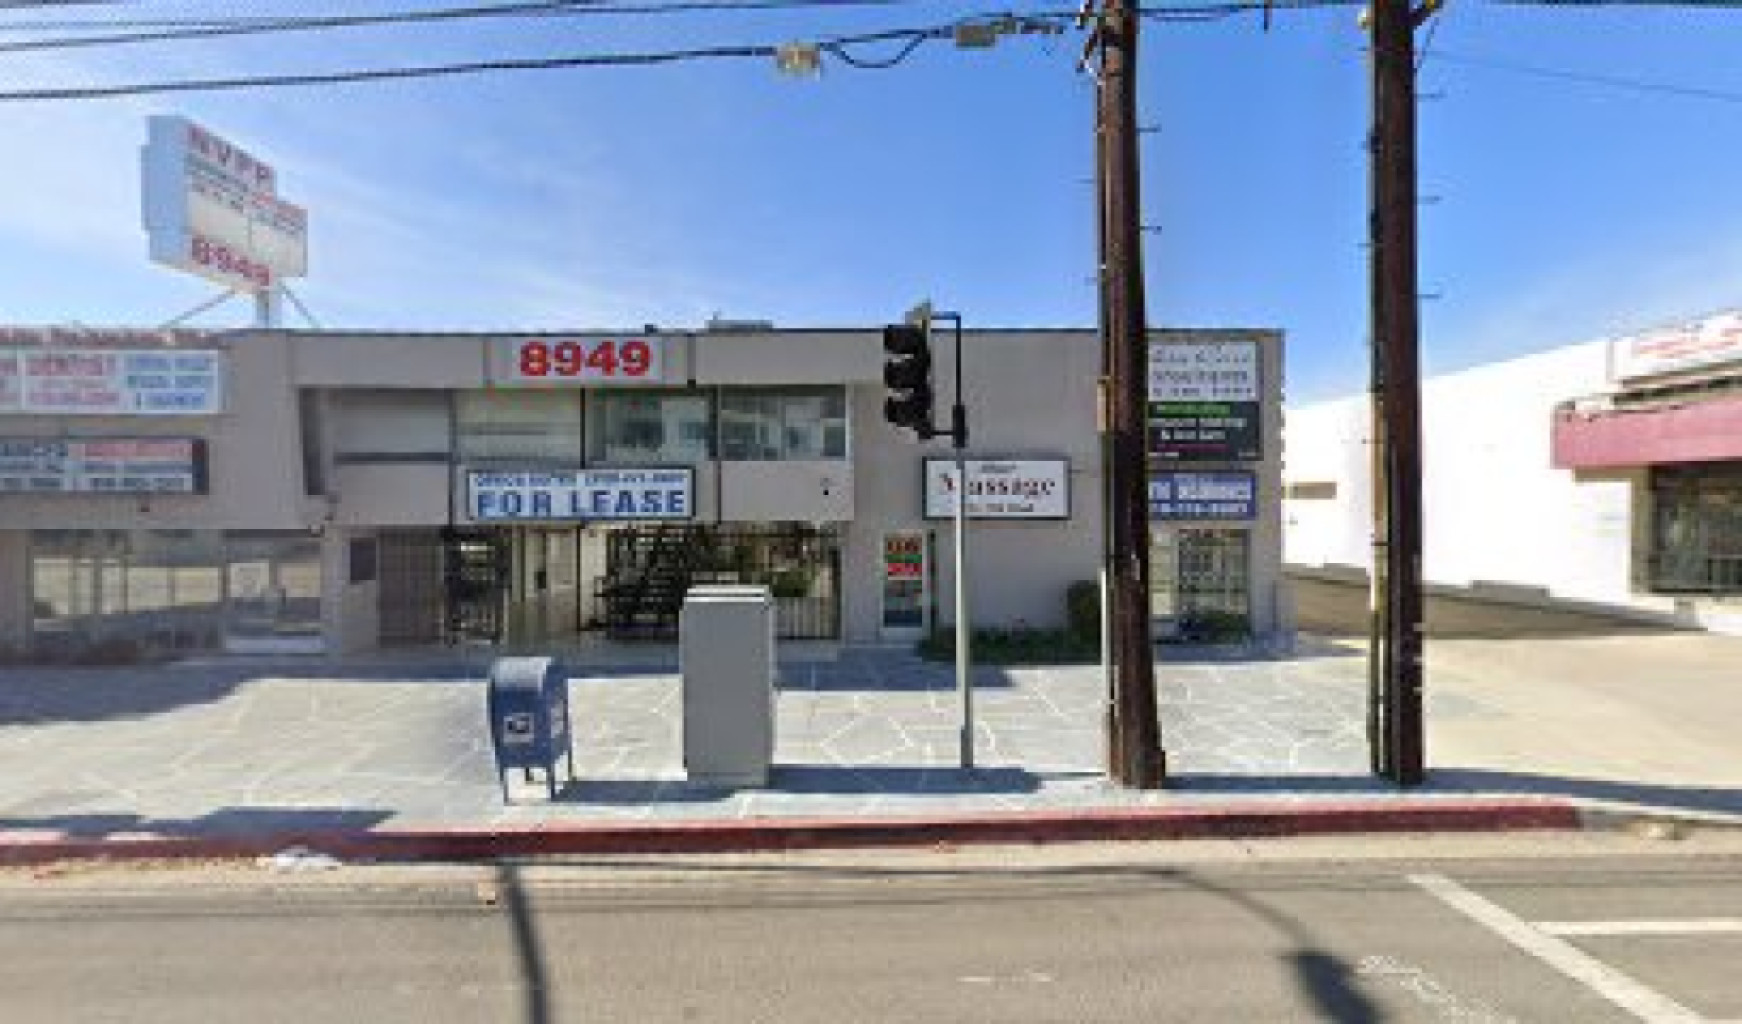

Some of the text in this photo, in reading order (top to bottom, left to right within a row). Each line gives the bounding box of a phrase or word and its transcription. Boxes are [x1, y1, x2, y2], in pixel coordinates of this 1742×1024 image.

[191, 233, 270, 286] 8949
[519, 340, 651, 377] 8949
[477, 489, 685, 516] FOR LEASE
